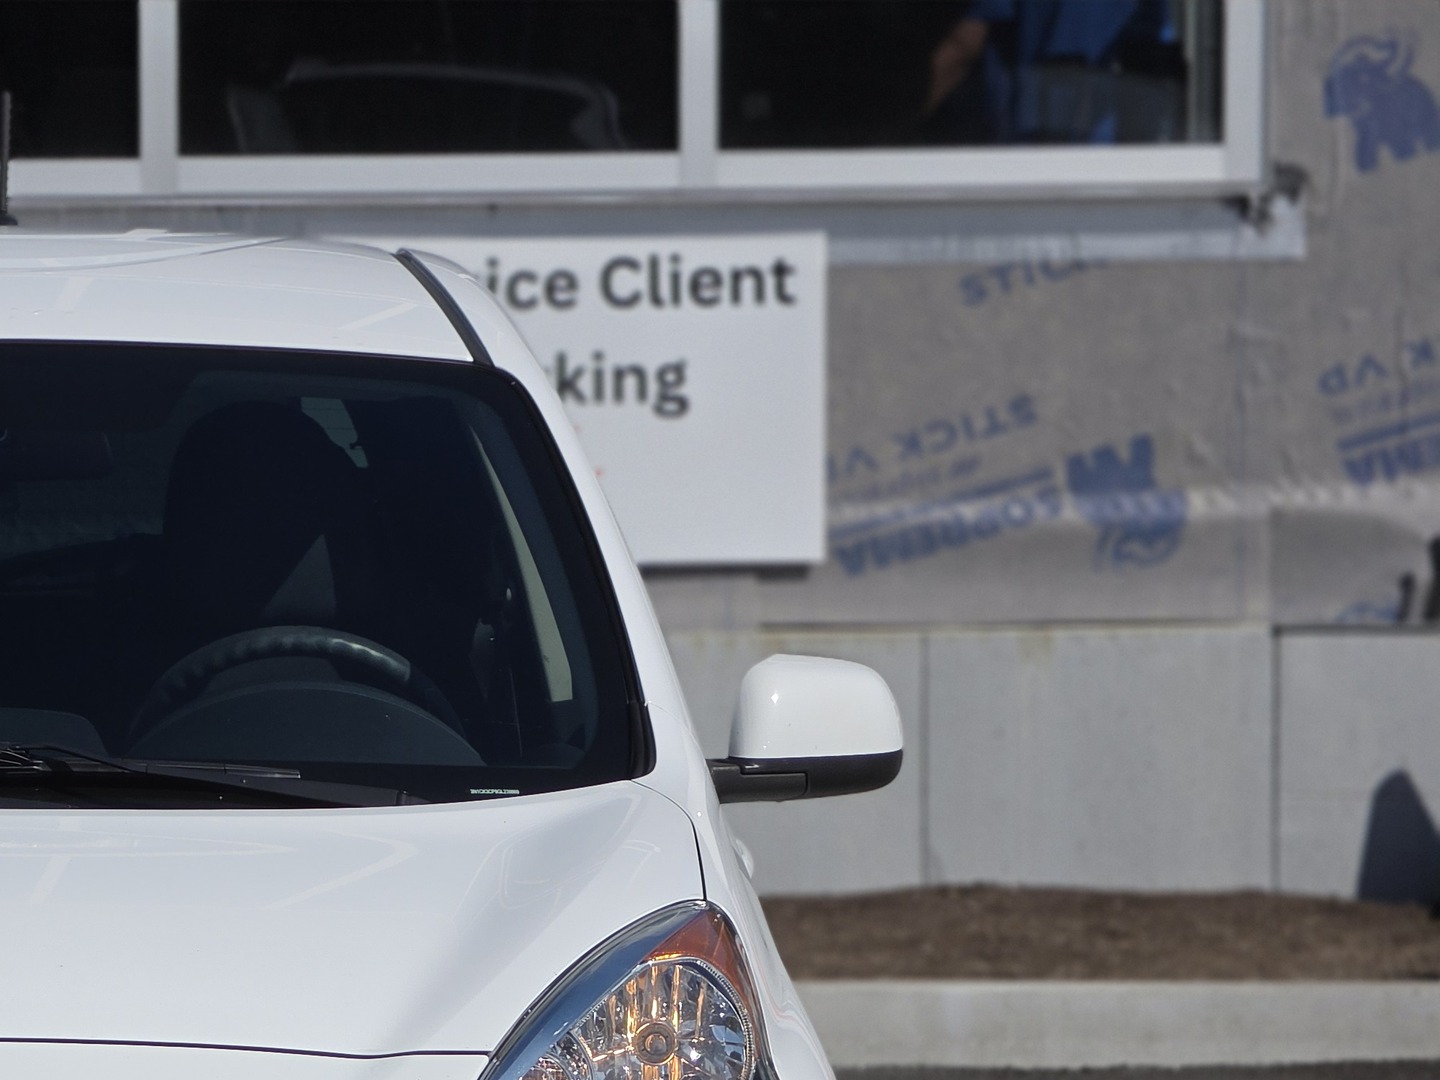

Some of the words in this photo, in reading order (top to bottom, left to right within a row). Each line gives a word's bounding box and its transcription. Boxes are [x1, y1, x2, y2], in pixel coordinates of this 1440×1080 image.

[482, 256, 580, 311] ice
[599, 252, 798, 309] Client
[959, 258, 1108, 306] STIC
[545, 350, 690, 419] king
